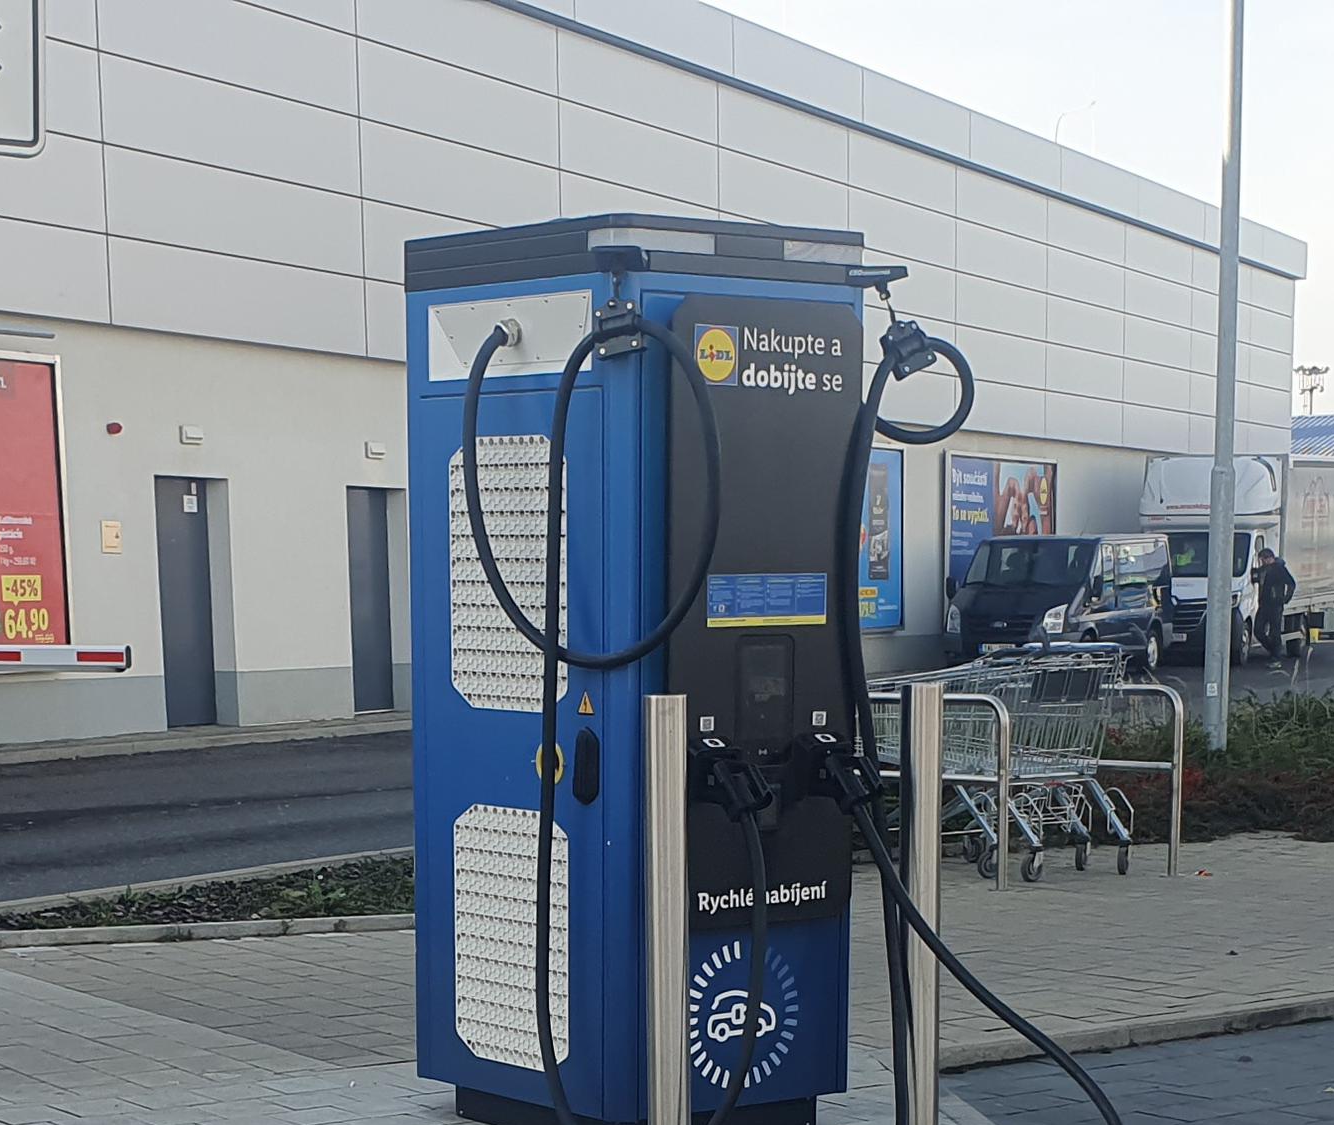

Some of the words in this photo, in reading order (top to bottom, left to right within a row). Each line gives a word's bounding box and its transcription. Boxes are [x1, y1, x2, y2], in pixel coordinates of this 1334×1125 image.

[743, 326, 826, 360] Nakupte
[831, 338, 842, 356] a
[741, 363, 817, 395] dobijte
[822, 373, 843, 392] se
[5, 578, 38, 597] -45%
[4, 608, 49, 639] 64.90
[697, 888, 754, 915] Rychlé
